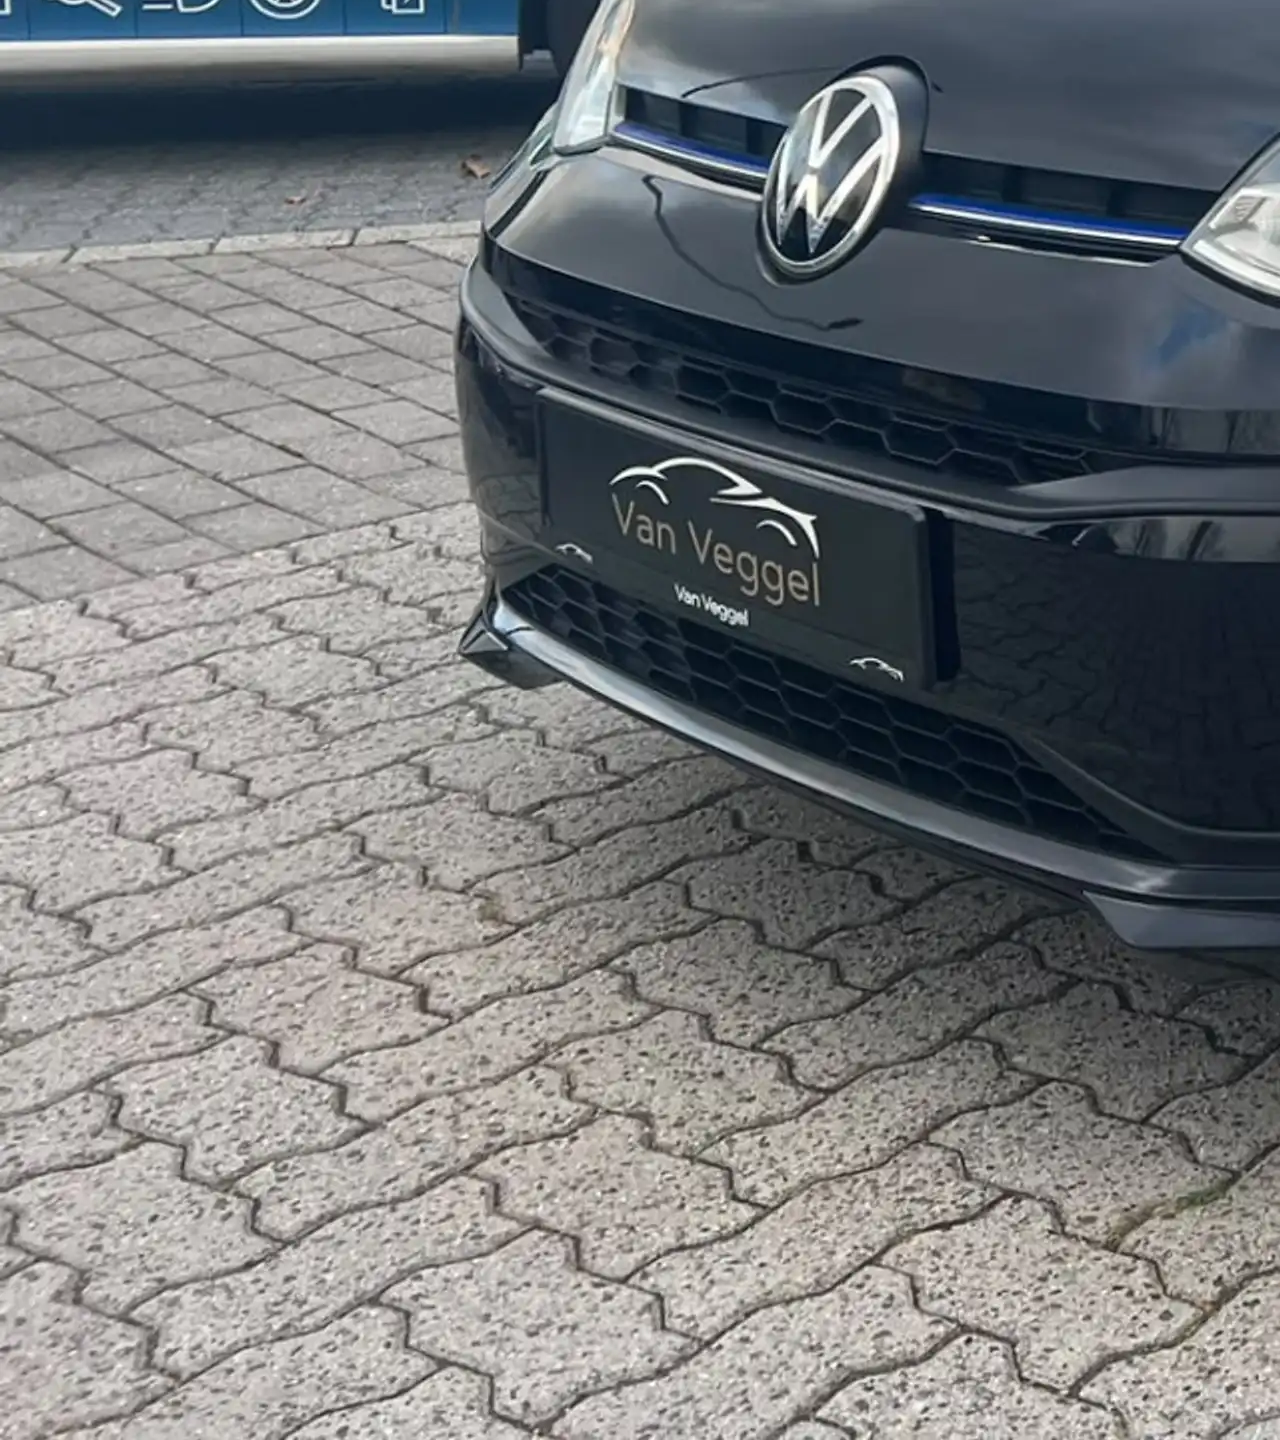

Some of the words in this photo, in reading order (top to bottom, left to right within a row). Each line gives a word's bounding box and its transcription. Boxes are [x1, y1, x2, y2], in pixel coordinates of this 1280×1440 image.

[612, 493, 676, 555] Van
[688, 520, 820, 606] Veggel
[674, 583, 701, 609] Van
[701, 592, 749, 627] Veggel
